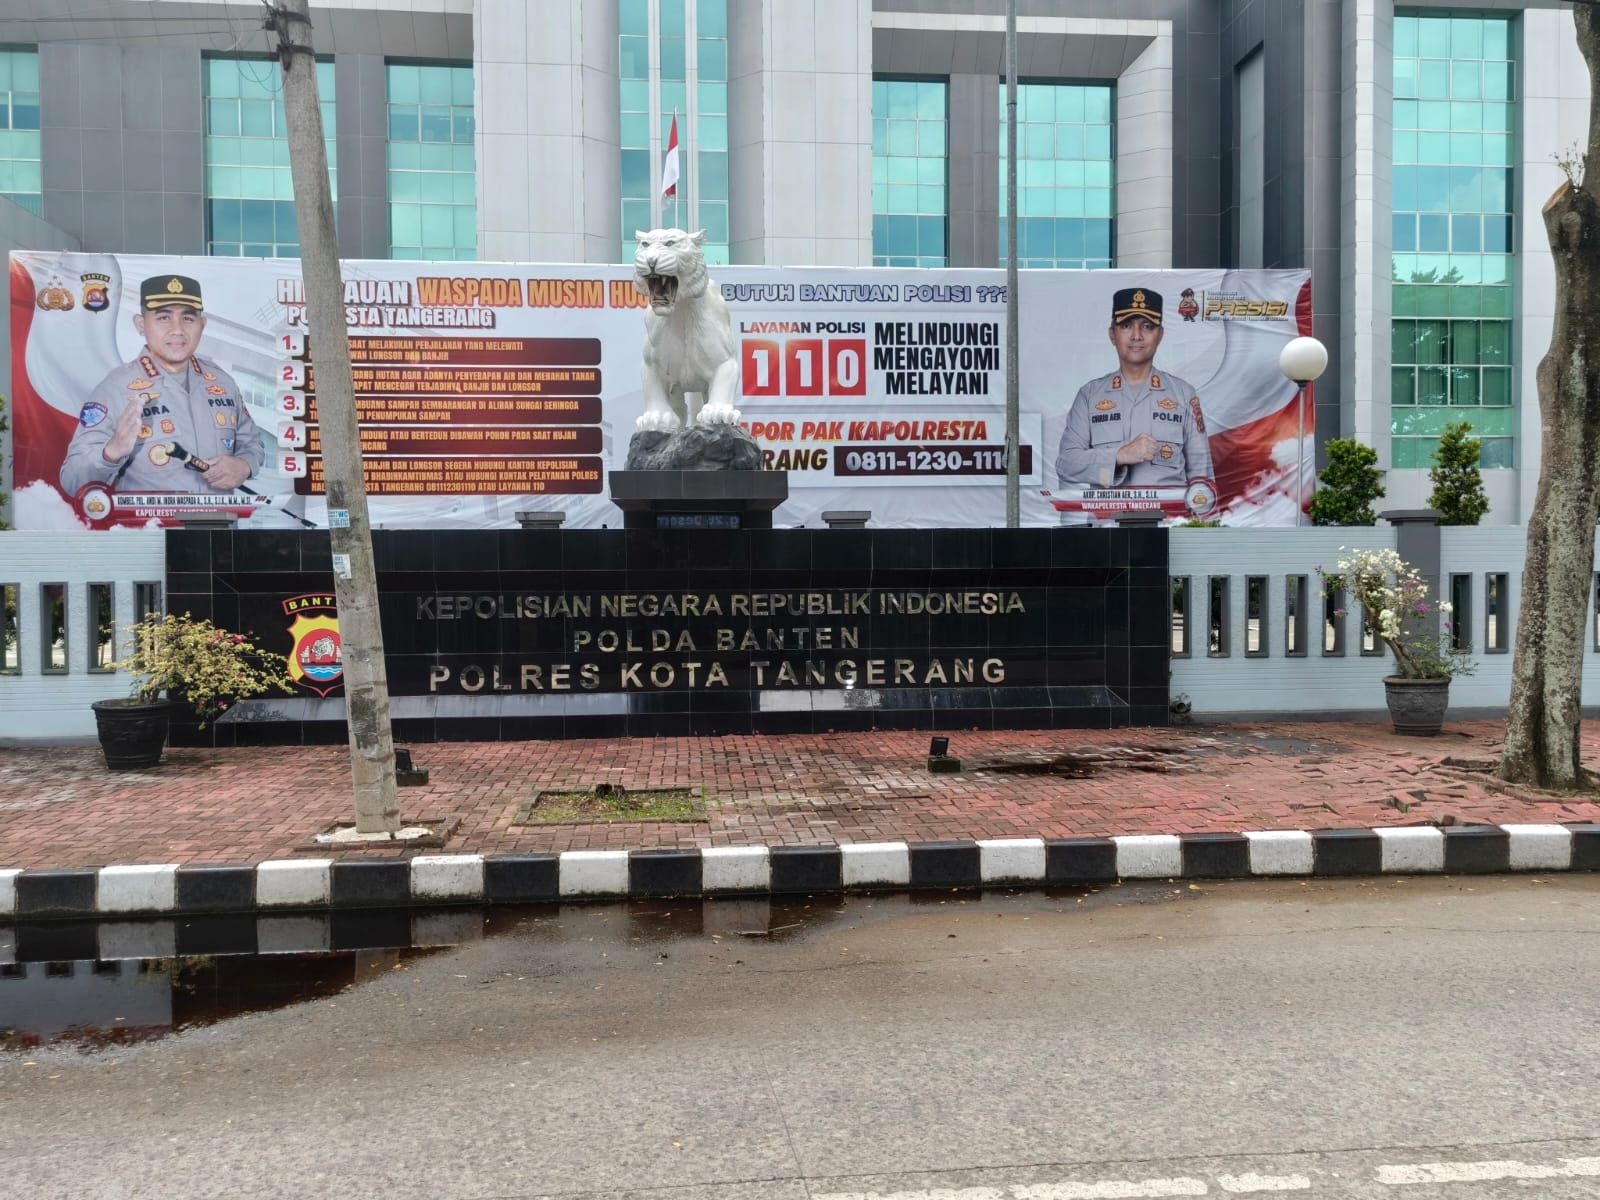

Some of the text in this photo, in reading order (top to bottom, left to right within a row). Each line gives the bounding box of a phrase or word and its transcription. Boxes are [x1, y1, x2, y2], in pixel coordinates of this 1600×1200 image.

[277, 279, 411, 306] HIAUAN
[417, 277, 522, 307] WASPADA
[528, 279, 604, 308] MUSIM
[721, 284, 794, 302] BUTUH
[800, 285, 898, 302] BANTUAN
[904, 285, 971, 302] POLISI
[385, 306, 496, 329] TANGERANG
[740, 321, 866, 333] LAYANAN POLISI
[874, 322, 999, 346] MELINDUNGI
[282, 335, 297, 350] 1.
[368, 340, 413, 350] MELAKUKAN
[415, 340, 463, 351] PERJALANAN
[464, 341, 484, 351] YANG
[486, 341, 524, 351] MELEWATI
[369, 351, 403, 361] LONGSOR
[405, 351, 421, 361] DAN
[422, 351, 449, 361] BANJIR
[874, 347, 1000, 370] MENGAYOMI
[283, 366, 298, 381] 2.
[375, 370, 400, 380] HUTAN
[402, 370, 422, 380] AGAR
[424, 370, 452, 380] ADANYA
[455, 371, 502, 381] PENYERAPAN
[503, 371, 516, 381] AIR
[517, 371, 533, 381] DAN
[534, 371, 570, 381] MENAHAN
[572, 372, 595, 381] TANAH
[752, 349, 859, 388] 110
[374, 381, 415, 391] MENCEGAH
[463, 382, 490, 392] BANJIR
[491, 382, 507, 392] DAN
[508, 382, 541, 392] LONGSOR
[885, 372, 988, 395] MELAYANI
[208, 398, 235, 409] POLRI
[283, 396, 299, 411] 3.
[388, 400, 420, 410] SAMPAH
[478, 400, 487, 410] DI
[488, 400, 514, 410] ALIRAN
[515, 400, 542, 410] SUNGAI
[543, 401, 579, 410] SEHINGGA
[366, 411, 417, 421] PENUMPUKAN
[418, 411, 451, 421] SAMPAH
[1153, 412, 1182, 423] POLRI
[284, 426, 300, 441] 4.
[390, 431, 409, 440] ATAU
[411, 431, 448, 440] BERTEDUH
[450, 431, 483, 440] DIBAWAH
[485, 431, 510, 440] POHON
[511, 431, 531, 440] PADA
[532, 431, 551, 440] SAAT
[553, 431, 577, 440] HUJAN
[800, 421, 844, 441] PAK
[847, 420, 988, 441] KAPOLRESTA
[284, 456, 301, 472] 5.
[392, 461, 408, 470] DAN
[409, 461, 442, 470] LONGSOR
[444, 461, 472, 470] SEGERA
[474, 461, 506, 470] HUBUNGI
[507, 461, 535, 470] KANTOR
[537, 461, 578, 470] KEPOLISIAN
[445, 471, 464, 481] ATAU
[466, 471, 497, 481] HUBUNGI
[499, 471, 527, 481] KONTAK
[528, 471, 570, 481] PELAYANAN
[571, 471, 598, 481] POLRES
[381, 482, 424, 492] TANGERANG
[478, 482, 497, 492] ATAU
[498, 482, 531, 491] LAYANAN
[533, 482, 545, 491] 110
[1096, 490, 1121, 499] CHRISTIAN
[1081, 502, 1161, 510] WAKAPOLRESTA TANGERANG
[289, 597, 332, 610] BANT
[416, 592, 1026, 620] KEPOLISIAN NEGARA REPUBLIK INDONESIA
[574, 626, 858, 653] POLDA BANTEN
[430, 657, 1005, 692] POLRES KOTA TANGERANG
